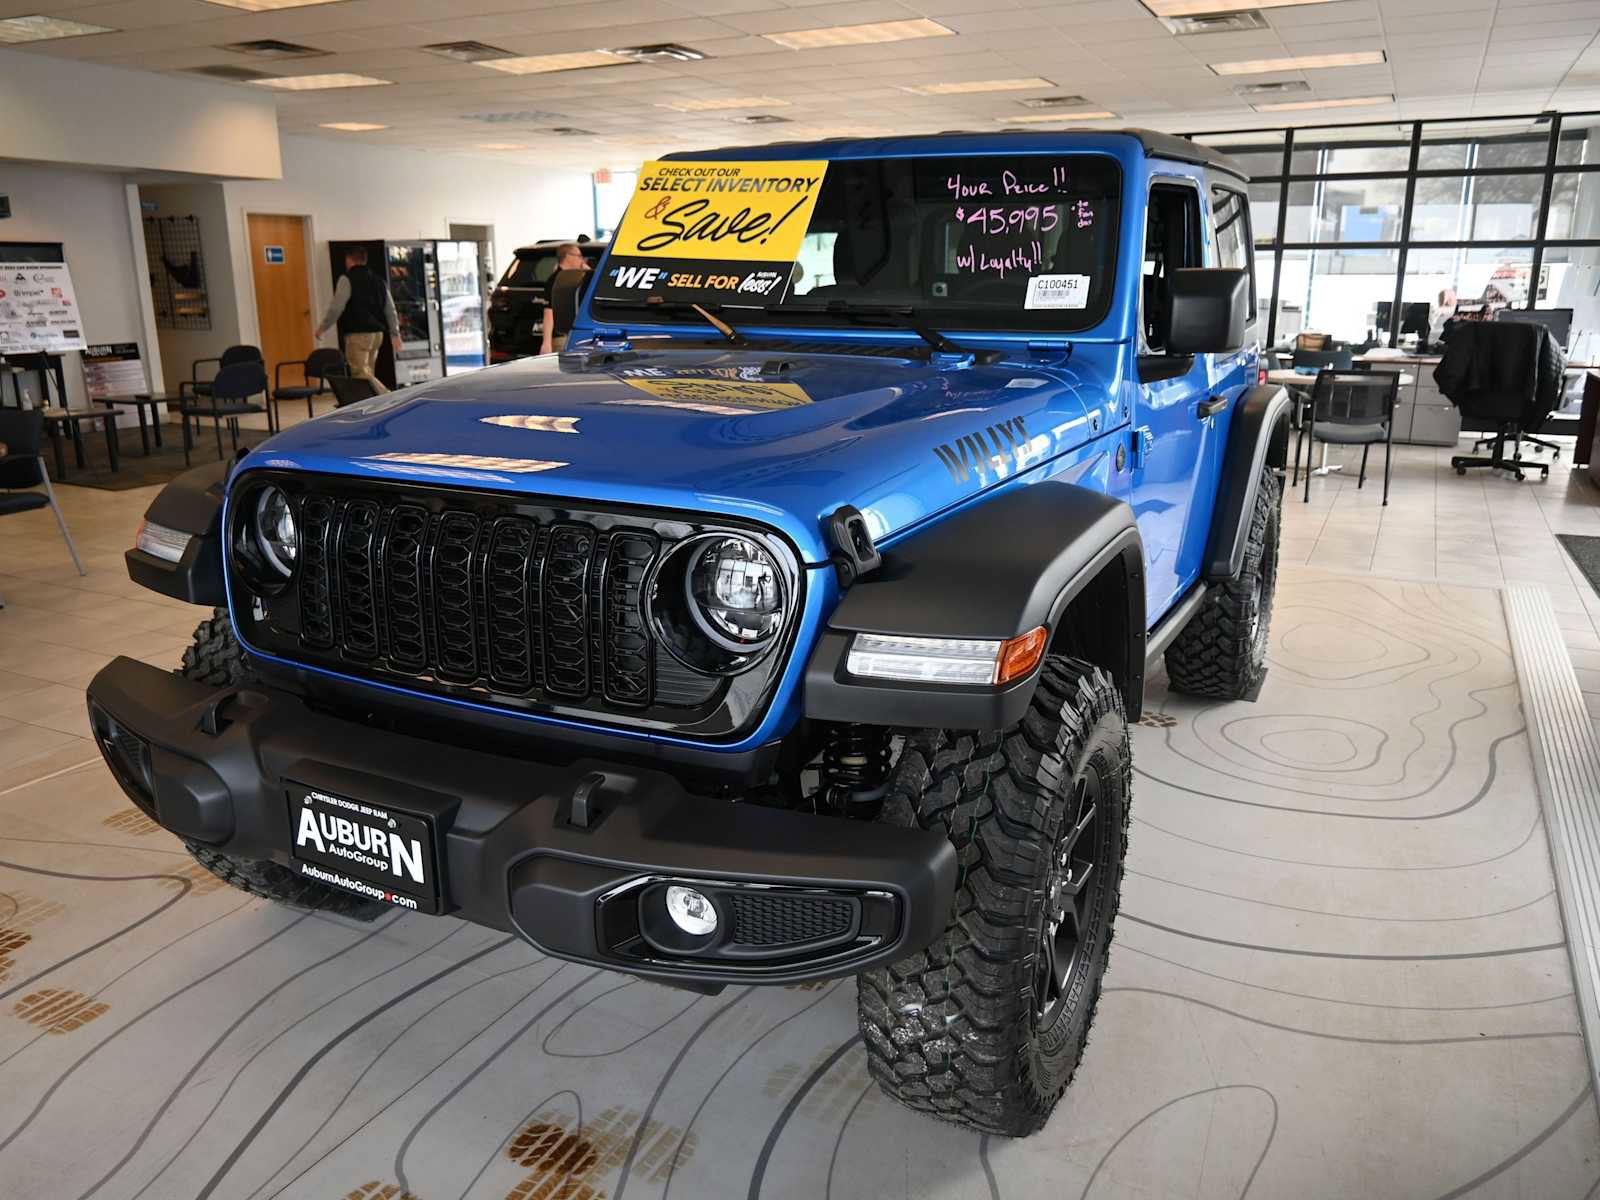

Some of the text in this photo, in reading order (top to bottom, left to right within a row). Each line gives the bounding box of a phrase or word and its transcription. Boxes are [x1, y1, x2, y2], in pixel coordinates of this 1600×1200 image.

[640, 177, 820, 192] SELECT INVENTORY
[659, 168, 741, 177] CHECK OUT OUR
[637, 195, 809, 251] & Save!
[955, 204, 1059, 235] $45,995
[668, 273, 703, 289] SELL
[704, 275, 740, 290] FOR
[737, 272, 783, 295] less!
[1037, 279, 1079, 290] C100451
[297, 807, 425, 884] AUBURN
[328, 843, 389, 871] AutoGroup
[302, 863, 418, 910] AuburnAutoGroup.com
